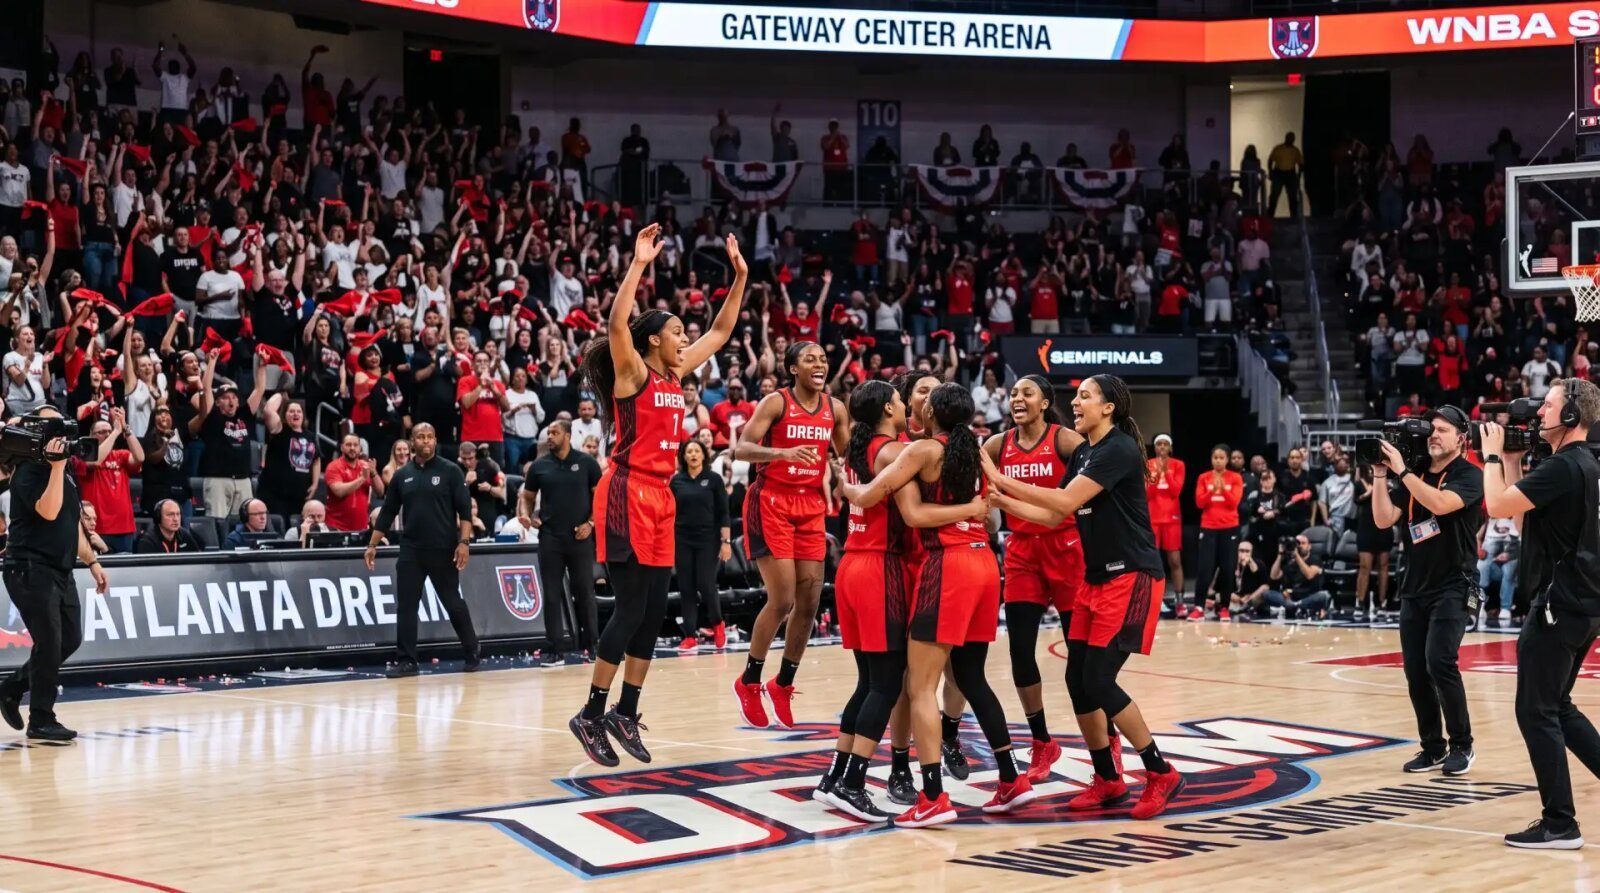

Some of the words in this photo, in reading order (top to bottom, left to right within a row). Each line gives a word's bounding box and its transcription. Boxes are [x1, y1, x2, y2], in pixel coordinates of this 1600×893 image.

[721, 13, 846, 43] GATEWAY
[855, 18, 955, 47] CENTER
[964, 22, 1052, 50] ARENA
[1407, 12, 1557, 45] WNBA
[1568, 9, 1600, 38] S
[860, 102, 899, 128] 110
[1050, 351, 1164, 365] SEMIFINALS
[654, 391, 685, 409] DREA
[673, 413, 679, 436] 1
[787, 424, 832, 441] DREAM
[1004, 462, 1053, 478] DREAM
[84, 579, 301, 641] ATLANTA
[309, 573, 463, 628] DRE
[945, 832, 1241, 878] WNBA
